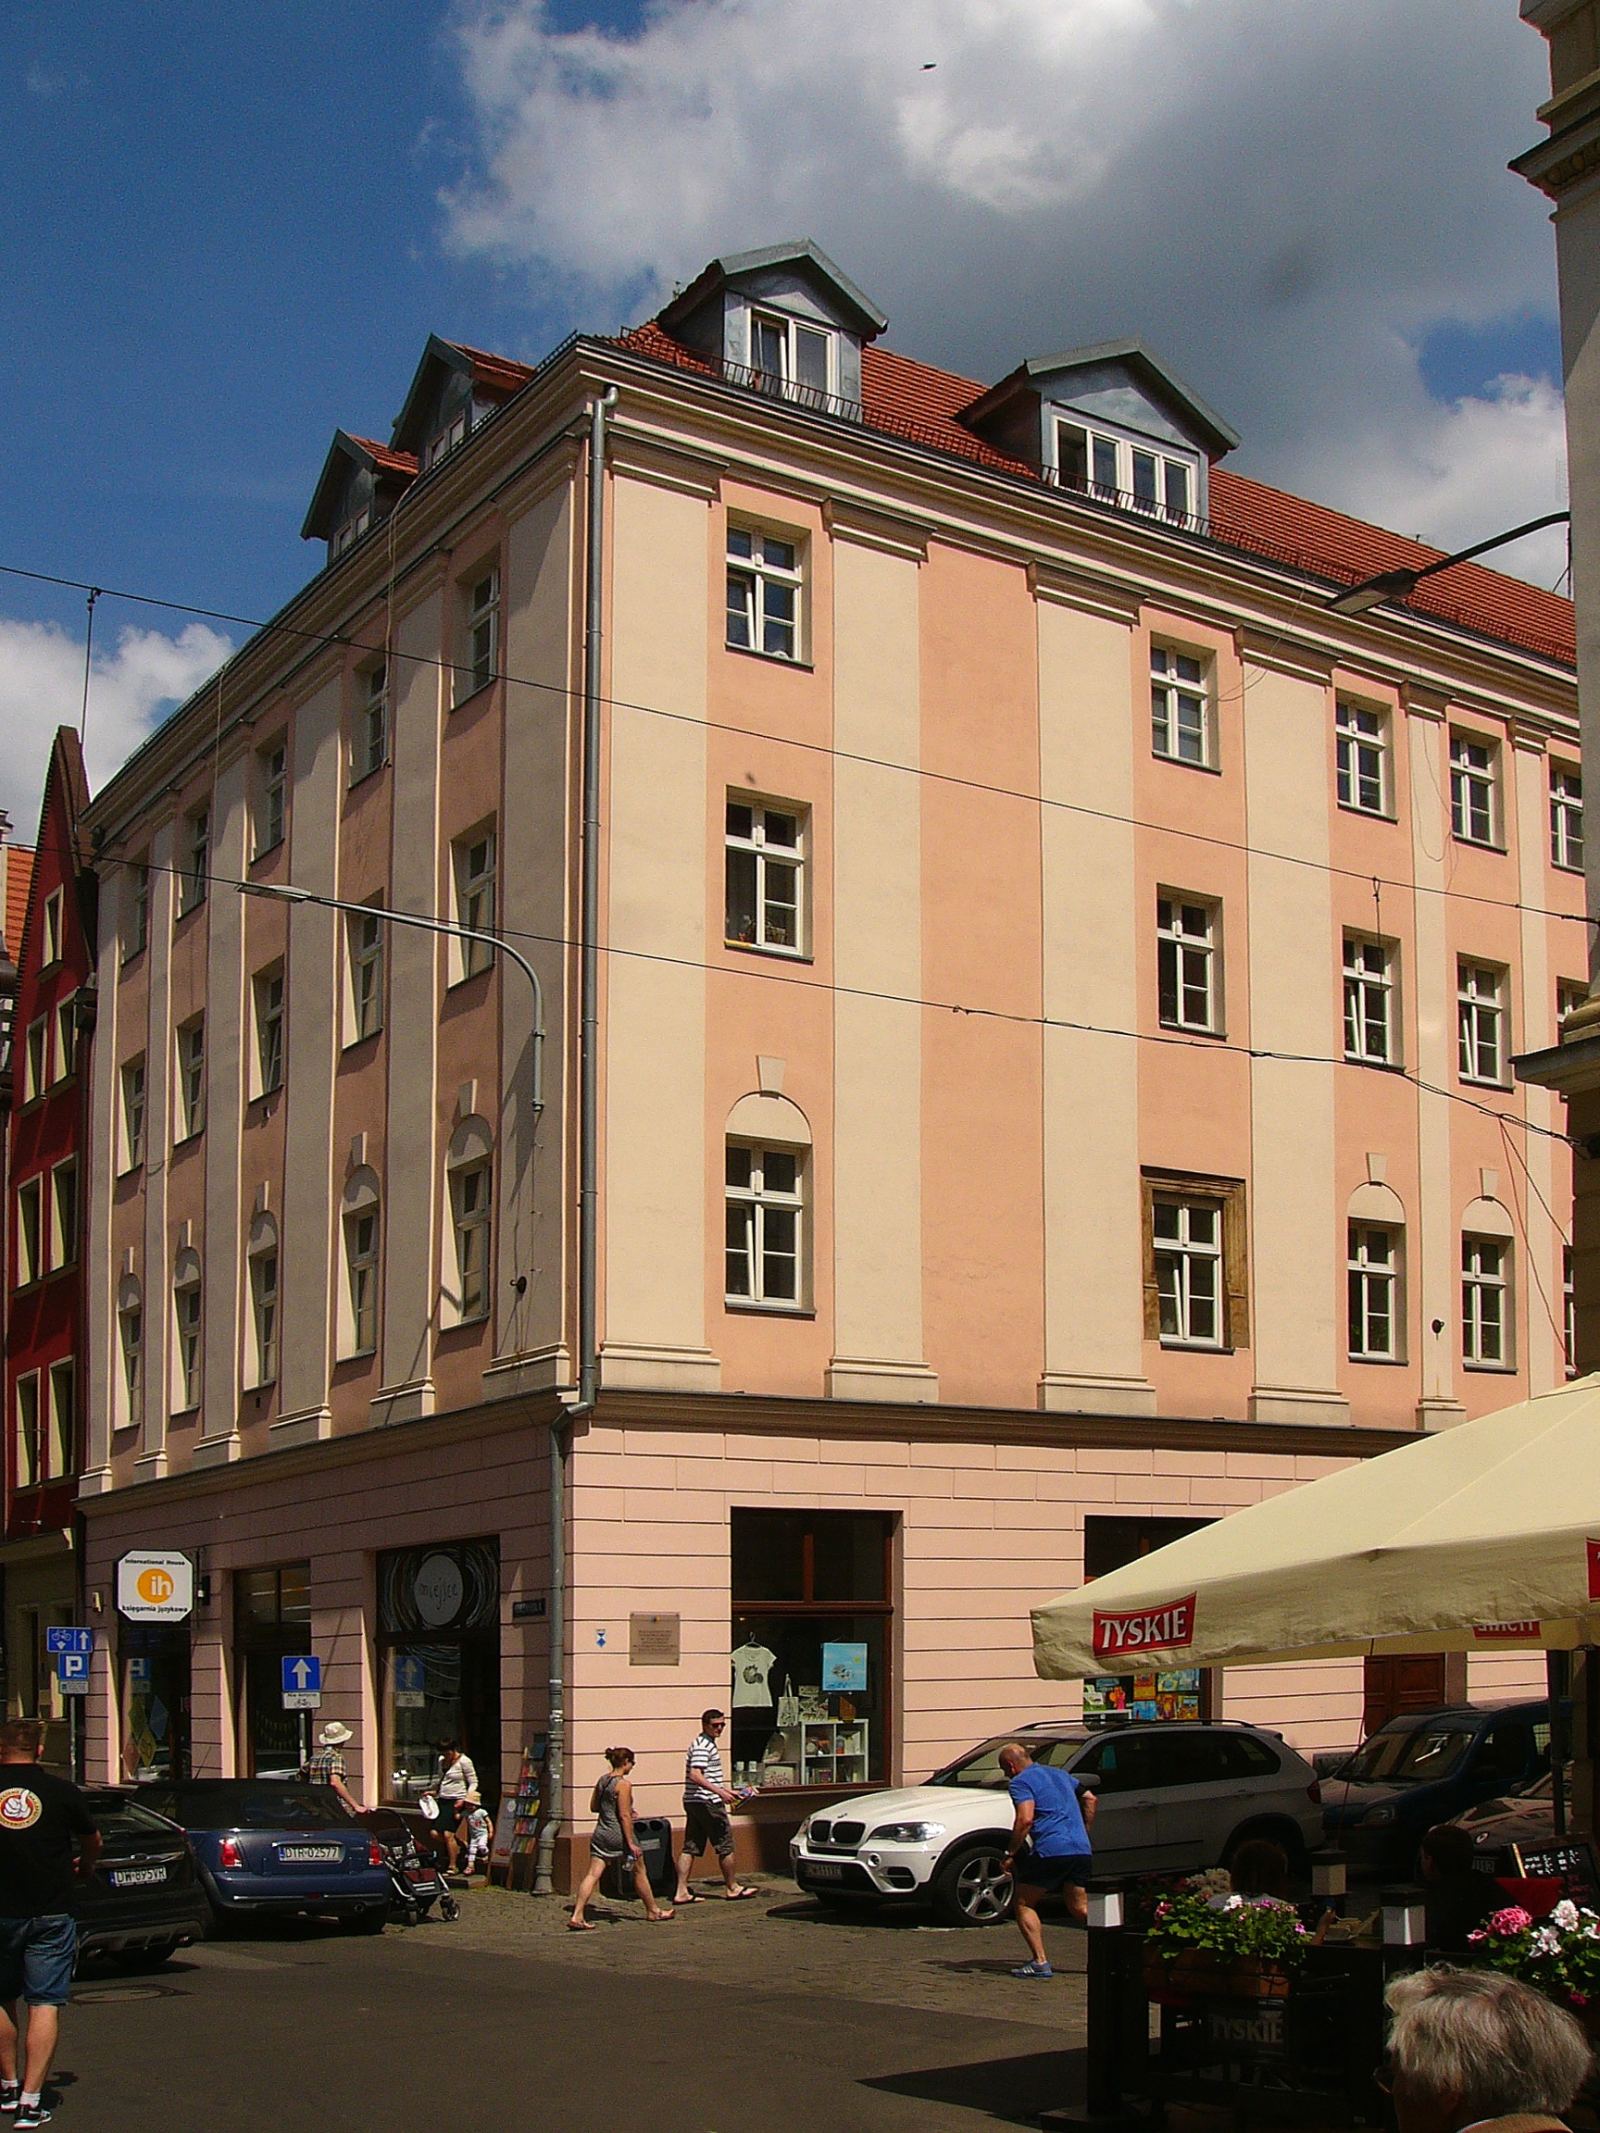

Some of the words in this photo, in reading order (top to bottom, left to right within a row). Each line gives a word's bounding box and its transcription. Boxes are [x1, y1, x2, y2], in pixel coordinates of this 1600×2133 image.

[151, 1575, 172, 1596] ih
[1100, 1606, 1187, 1649] TYSKIE
[65, 1655, 83, 1677] P
